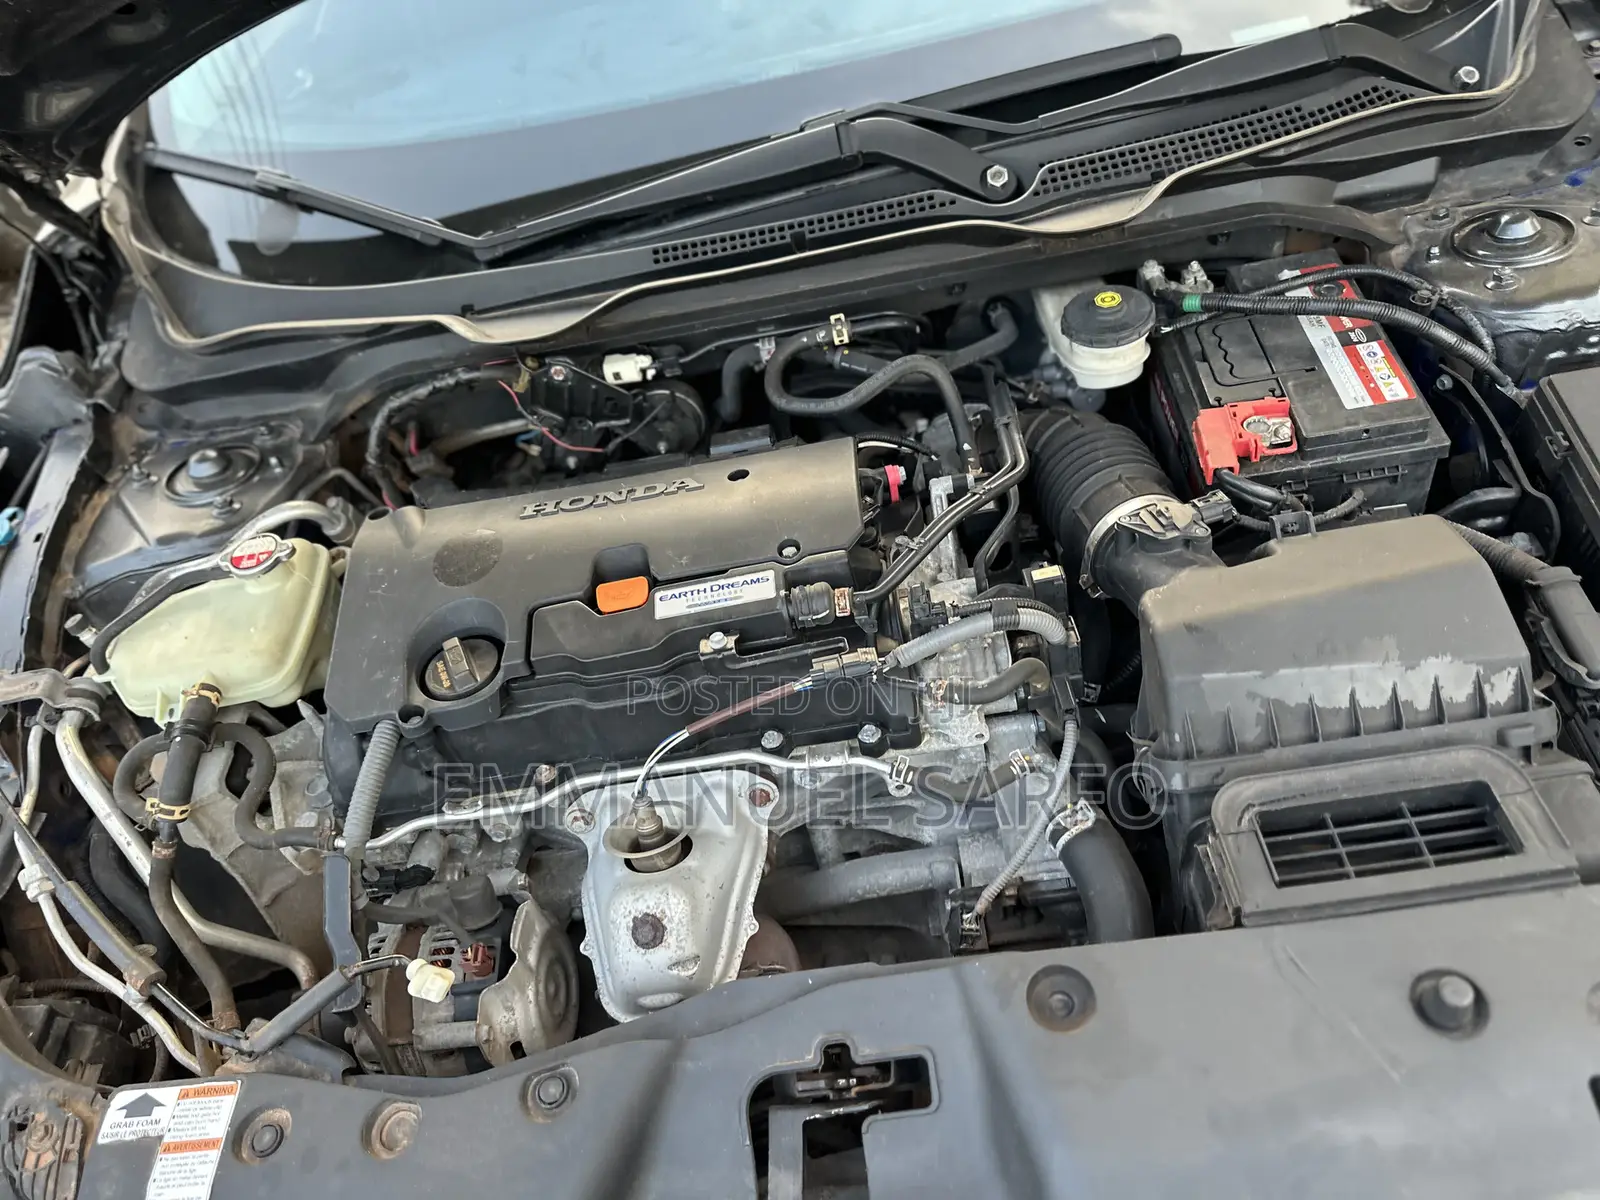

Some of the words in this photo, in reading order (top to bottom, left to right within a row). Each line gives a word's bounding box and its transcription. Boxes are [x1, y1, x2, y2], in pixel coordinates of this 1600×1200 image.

[519, 477, 705, 520] HONDA
[658, 587, 707, 602] EARTH
[710, 575, 770, 592] DREAMS
[193, 1086, 234, 1097] WARNING
[109, 1120, 134, 1130] GRAB
[136, 1118, 161, 1128] FOAM
[172, 1139, 220, 1151] AVERTISSEMENT
